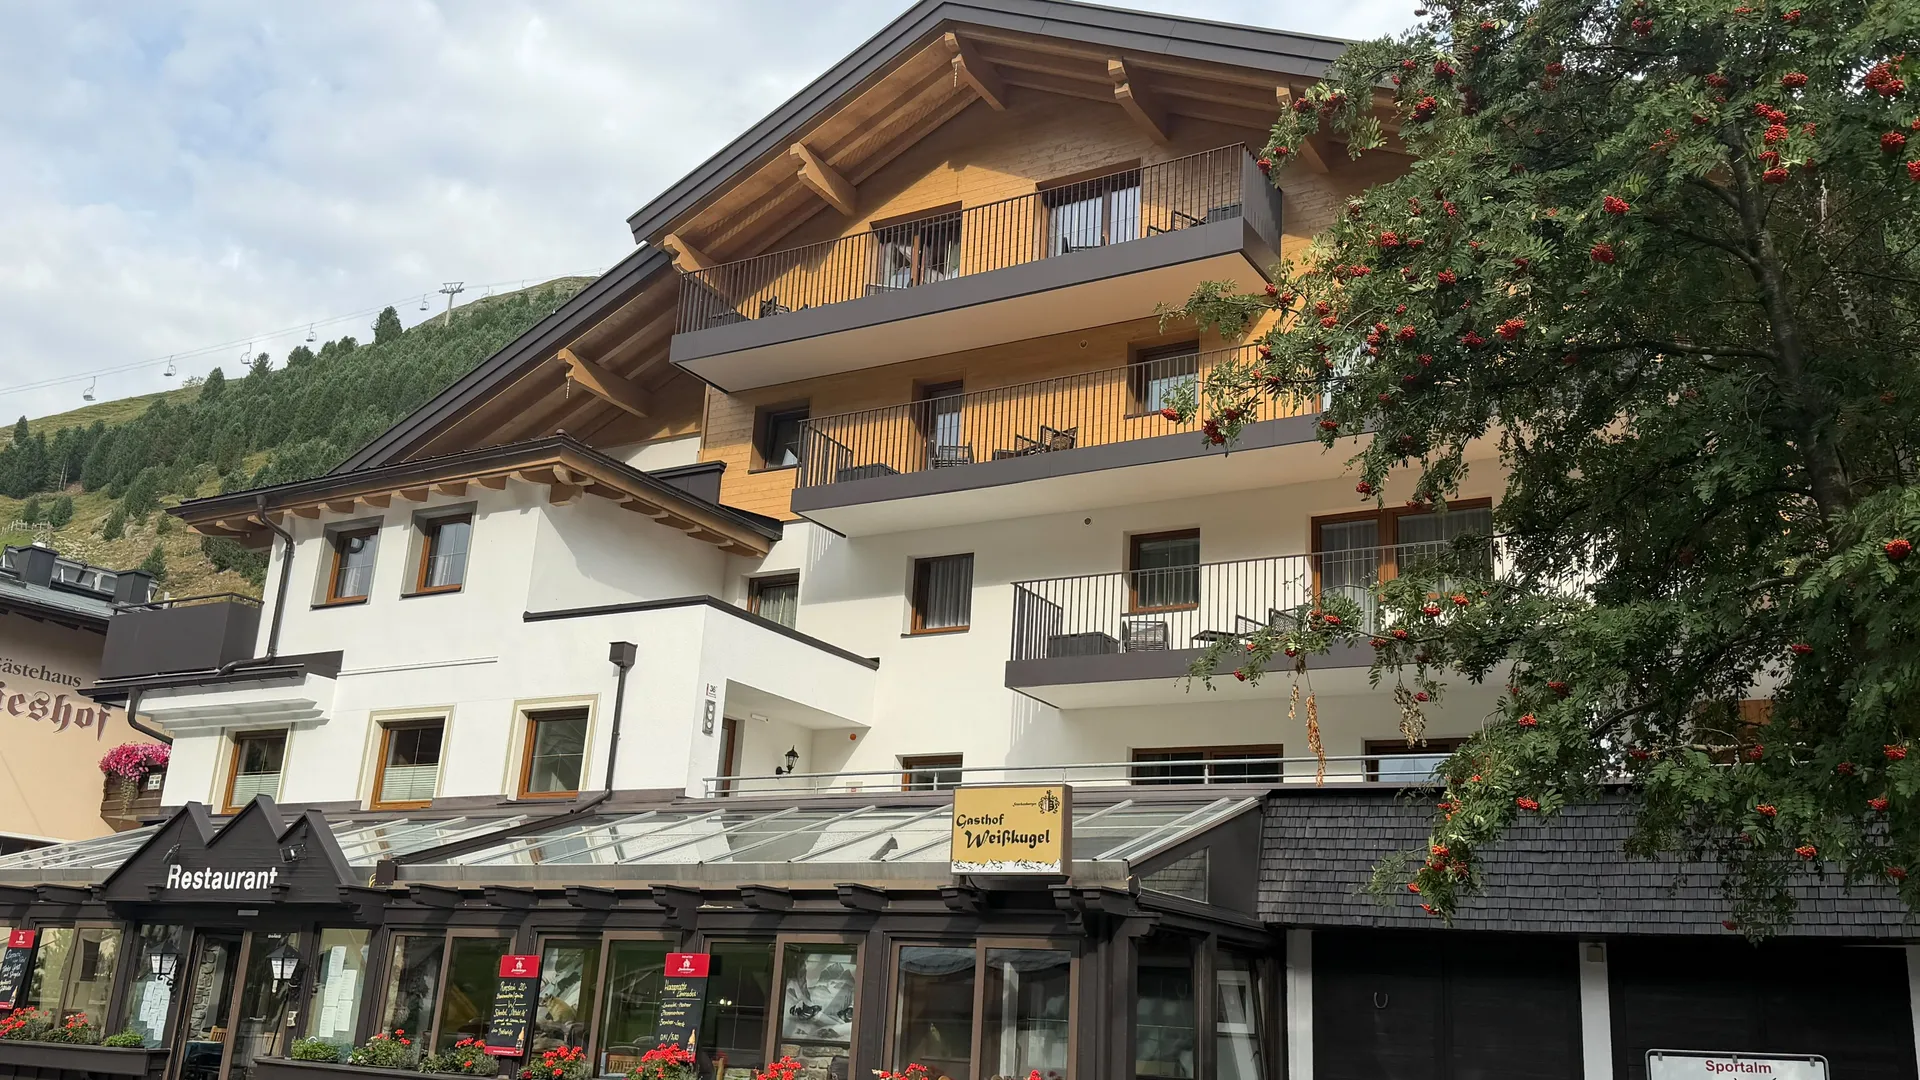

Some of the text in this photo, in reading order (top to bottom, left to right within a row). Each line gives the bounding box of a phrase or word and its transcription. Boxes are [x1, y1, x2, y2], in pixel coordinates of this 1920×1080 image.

[0, 657, 82, 688] ästehaus
[956, 813, 1005, 829] Gasthof
[964, 829, 1050, 849] Weißkugel
[166, 864, 278, 890] Restaurant
[1705, 1060, 1772, 1075] Sportalm
